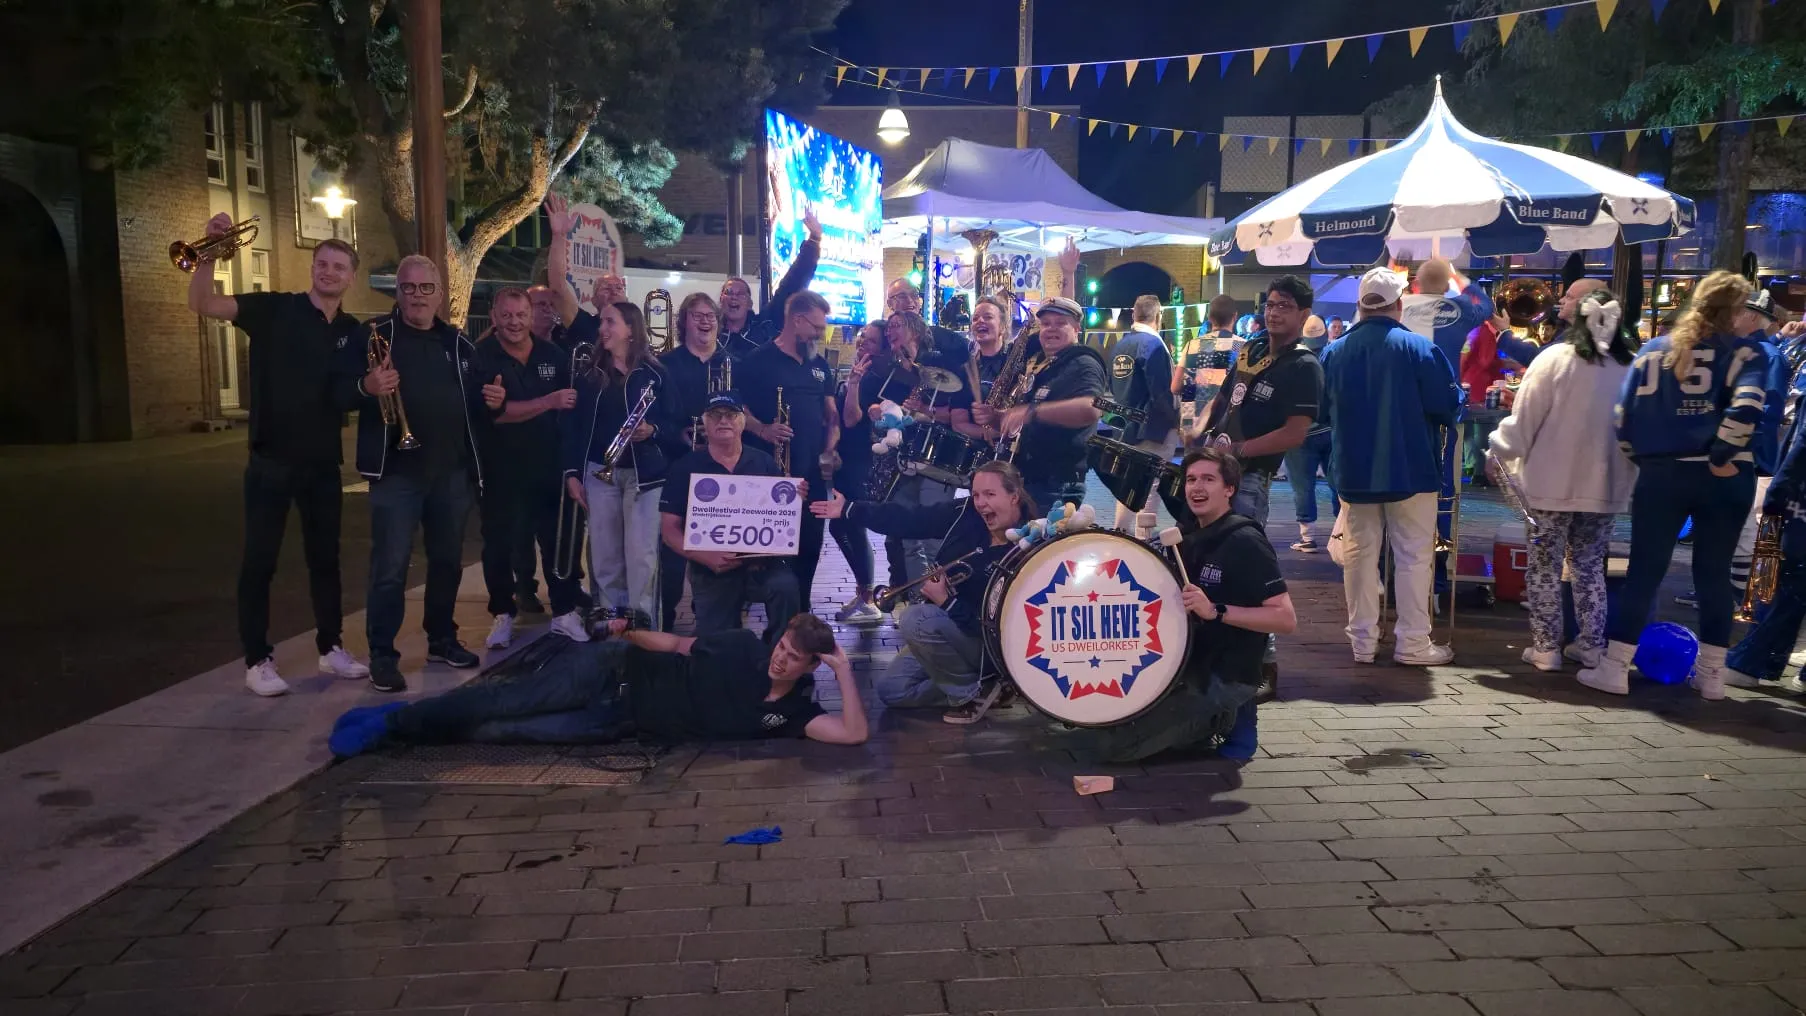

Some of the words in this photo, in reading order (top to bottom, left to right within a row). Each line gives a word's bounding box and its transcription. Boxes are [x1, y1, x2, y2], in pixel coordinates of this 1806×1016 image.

[1519, 205, 1549, 218] Blue
[1552, 207, 1588, 220] Band
[1315, 215, 1376, 232] Helmond
[573, 242, 581, 265] IT
[581, 244, 592, 267] SIL
[692, 506, 740, 514] Dweilfestival
[741, 508, 777, 516] Zeewolde
[774, 519, 790, 527] prijs
[710, 525, 774, 546] €500
[1050, 606, 1067, 641] IT
[1071, 605, 1096, 641] SIL
[1100, 603, 1141, 639] HEVE
[1051, 642, 1066, 652] US
[1068, 640, 1140, 652] DWEILORKEST
